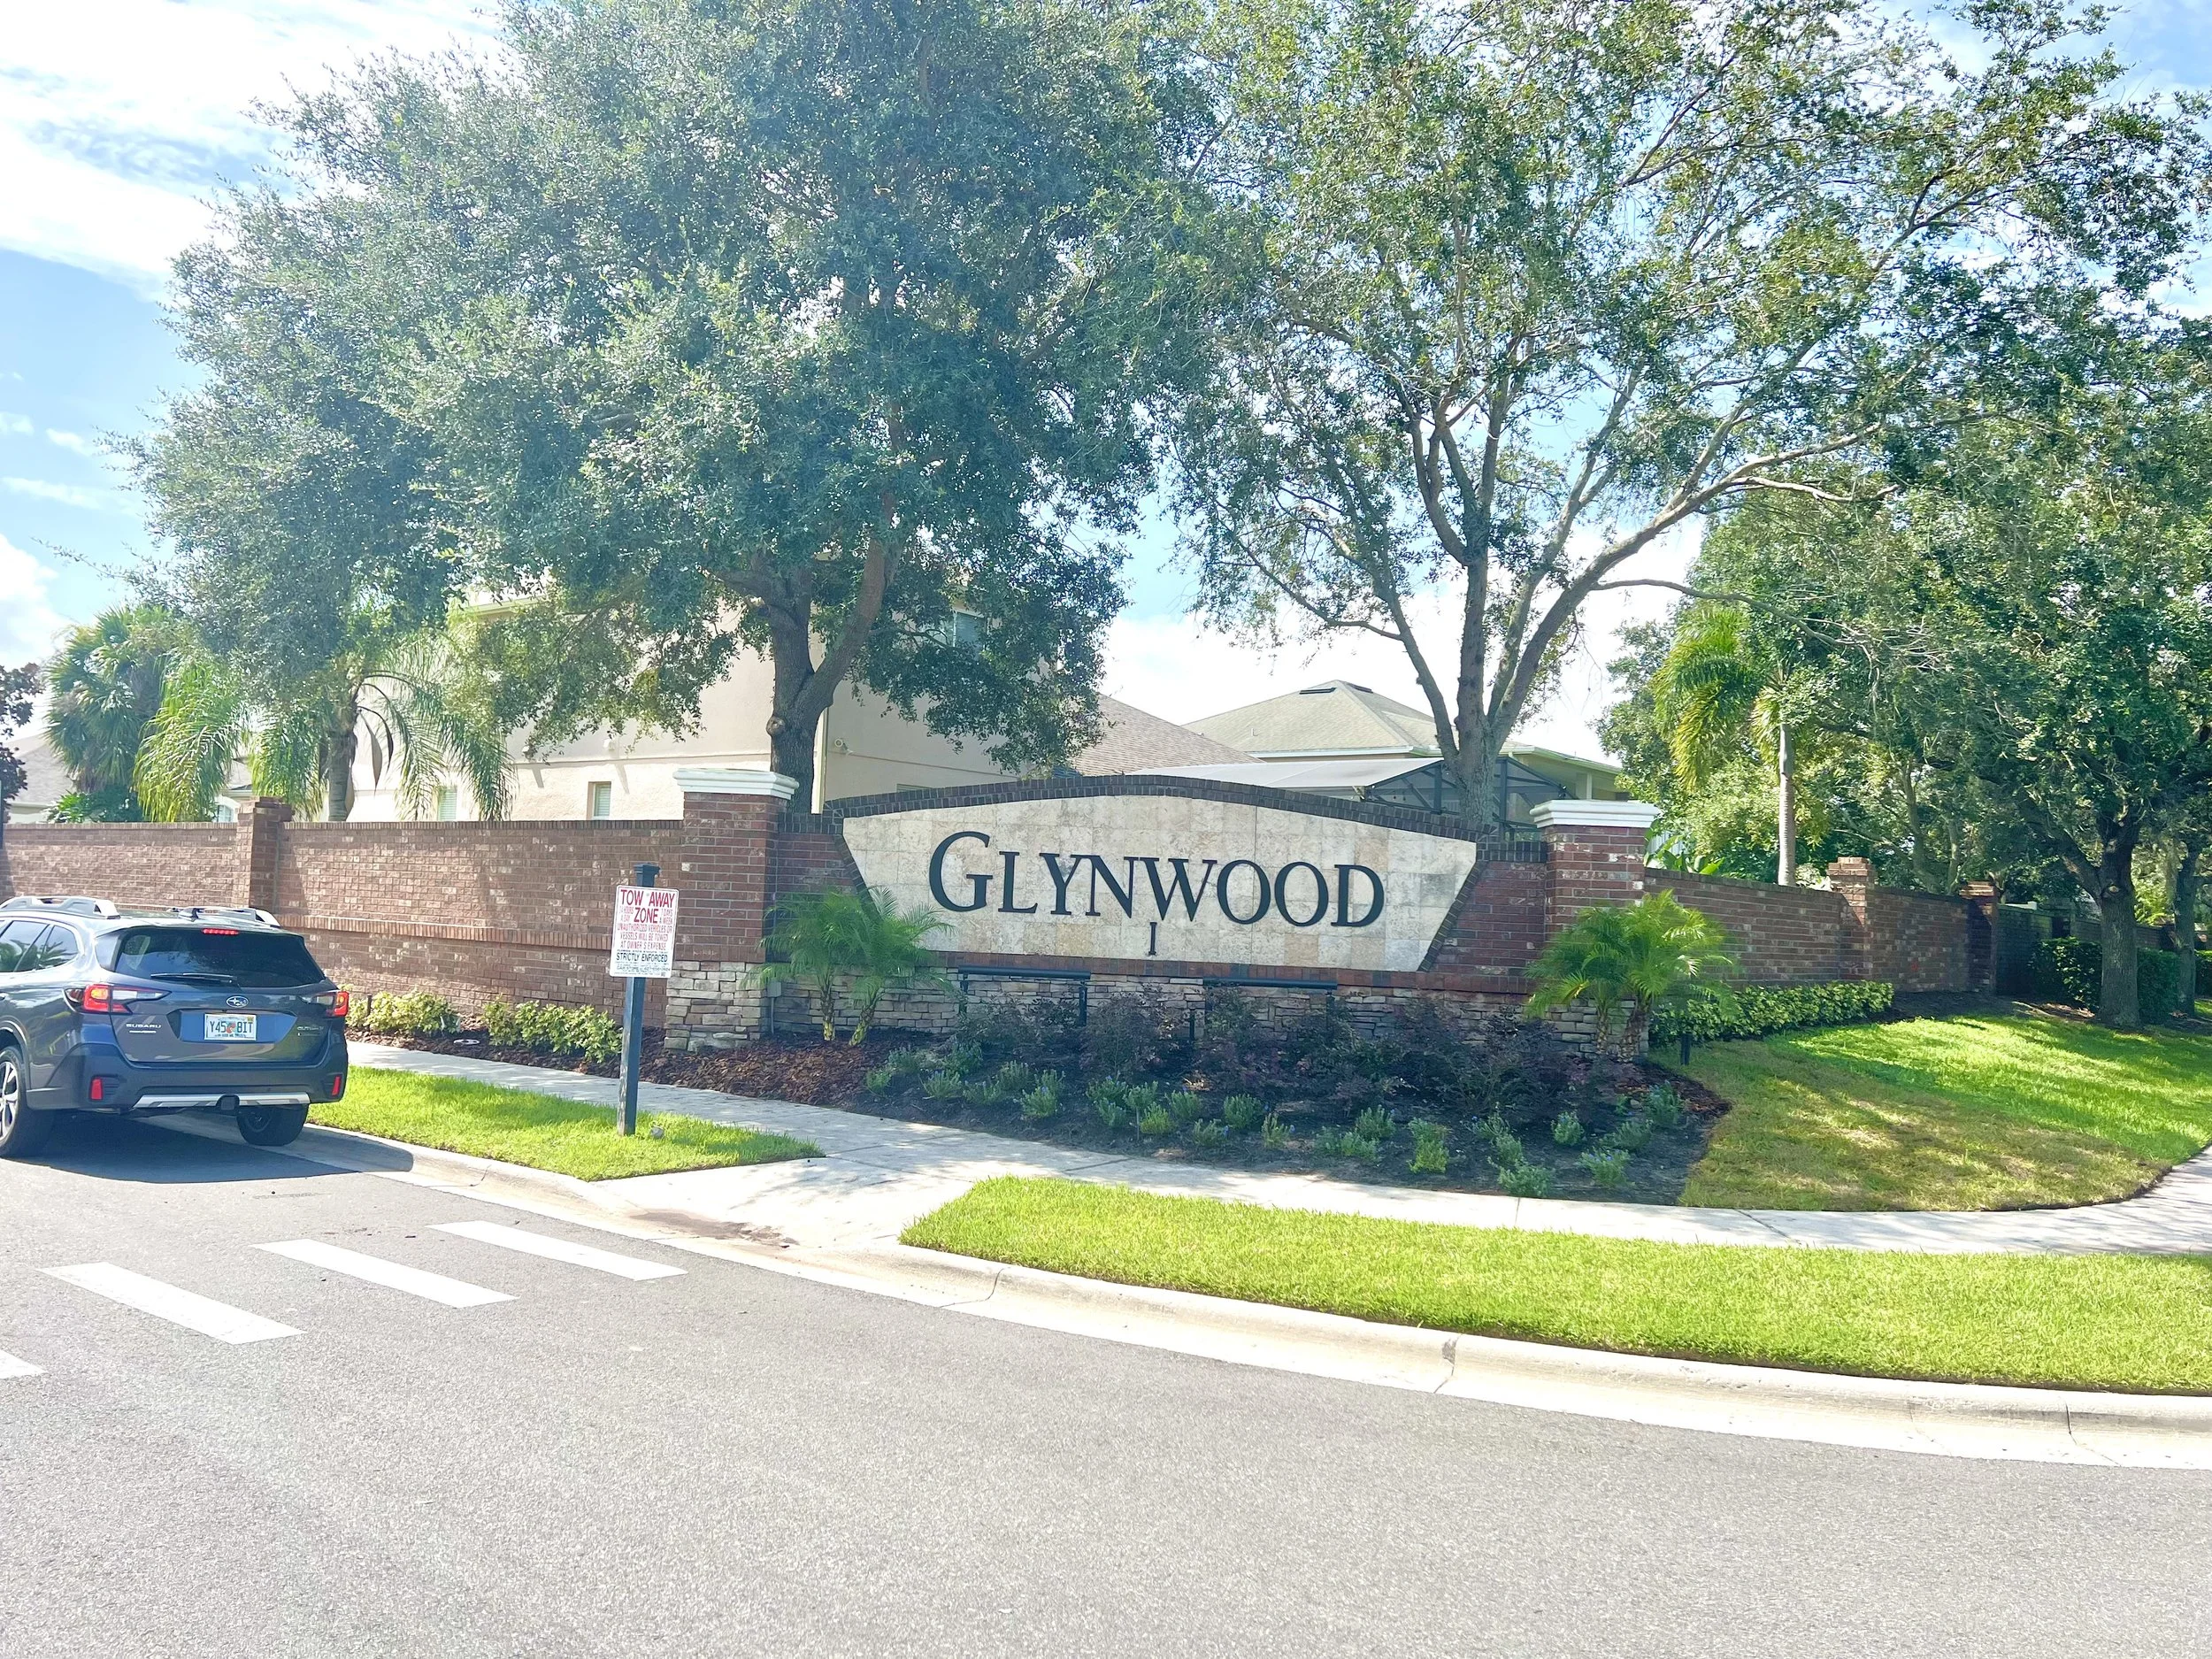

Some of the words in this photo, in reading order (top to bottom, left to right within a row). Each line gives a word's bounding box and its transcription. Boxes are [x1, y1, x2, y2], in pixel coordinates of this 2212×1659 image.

[929, 831, 1384, 927] GLYNWOOD
[620, 889, 643, 905] TOW
[649, 892, 675, 908] AWAY
[634, 908, 658, 923] ZONE
[620, 932, 638, 941] VESSELS
[1149, 921, 1157, 956] I
[620, 941, 626, 949] AT
[647, 942, 666, 951] EXPENSE
[641, 954, 668, 963] ENFORCED
[210, 1020, 227, 1033] Y45
